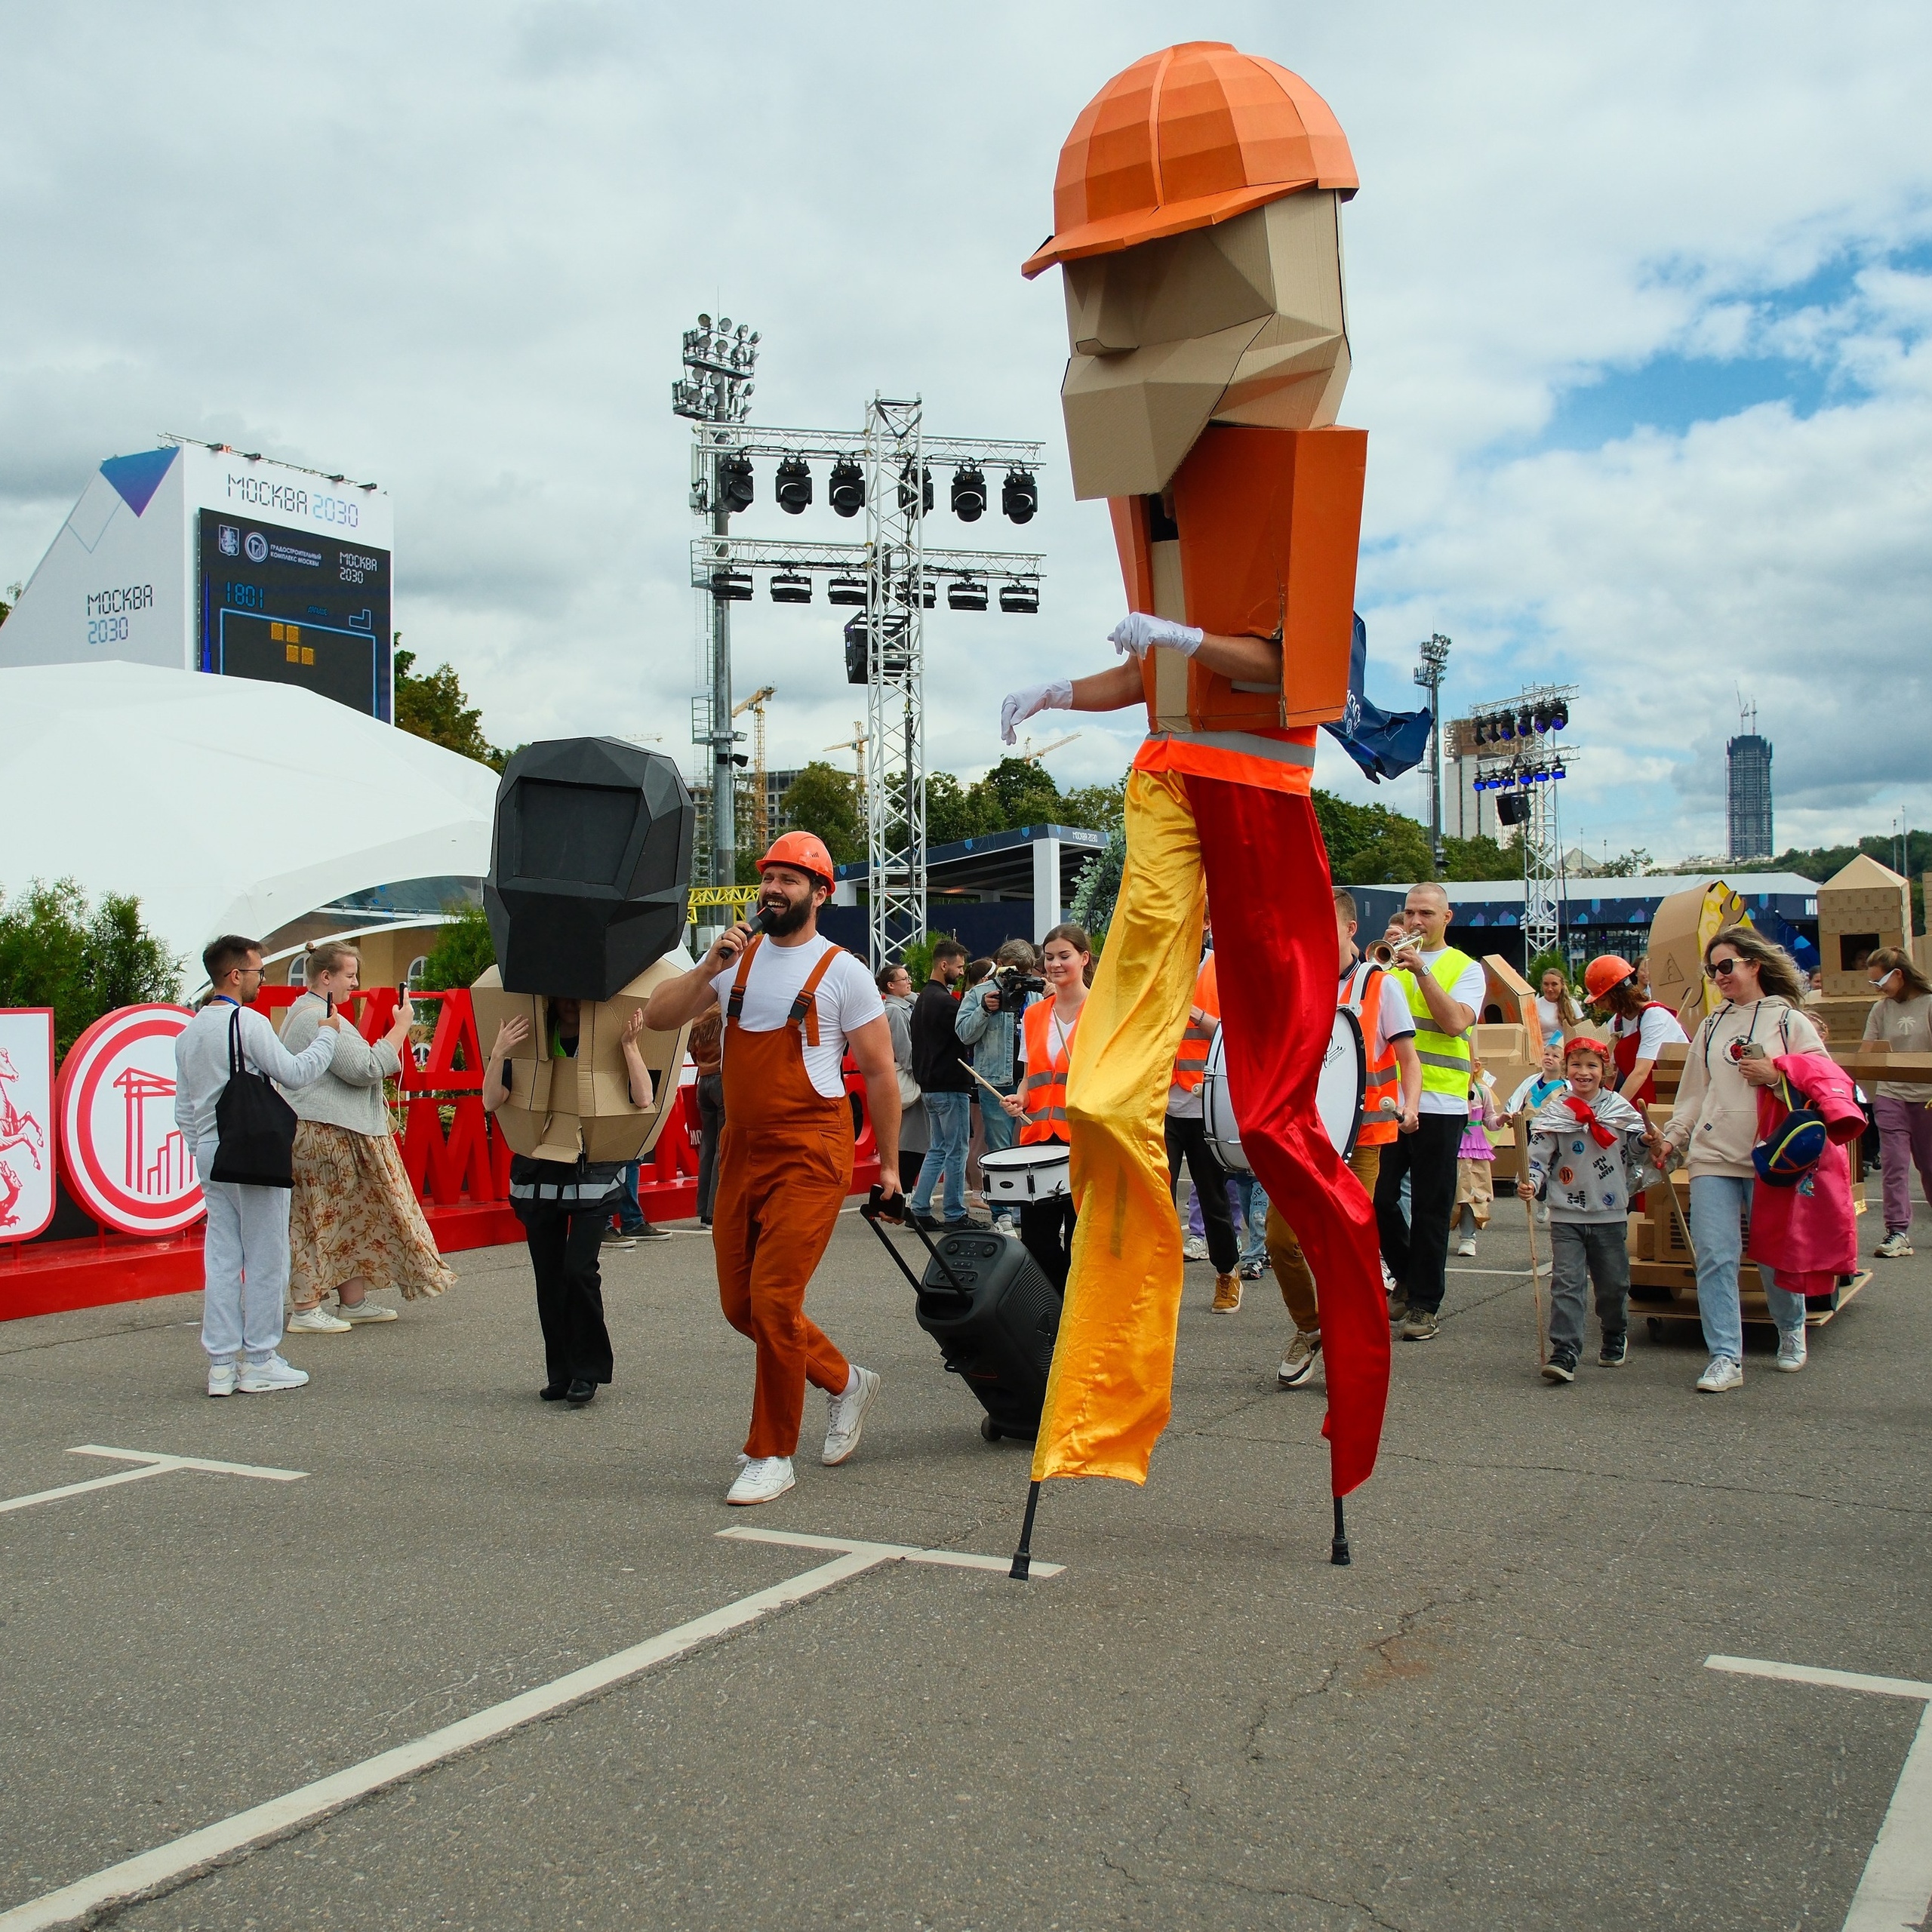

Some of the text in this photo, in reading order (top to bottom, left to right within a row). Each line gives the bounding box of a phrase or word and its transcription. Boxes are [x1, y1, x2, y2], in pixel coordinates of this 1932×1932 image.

[227, 473, 358, 528] МОСКВА 2030
[270, 552, 320, 568] КОМПЛЕКС МОСКВЫ
[339, 551, 377, 572] МОСКВА
[339, 566, 365, 584] 2030
[87, 584, 153, 617] МОСКВА
[226, 580, 263, 609] 1801
[88, 616, 129, 645] 2030
